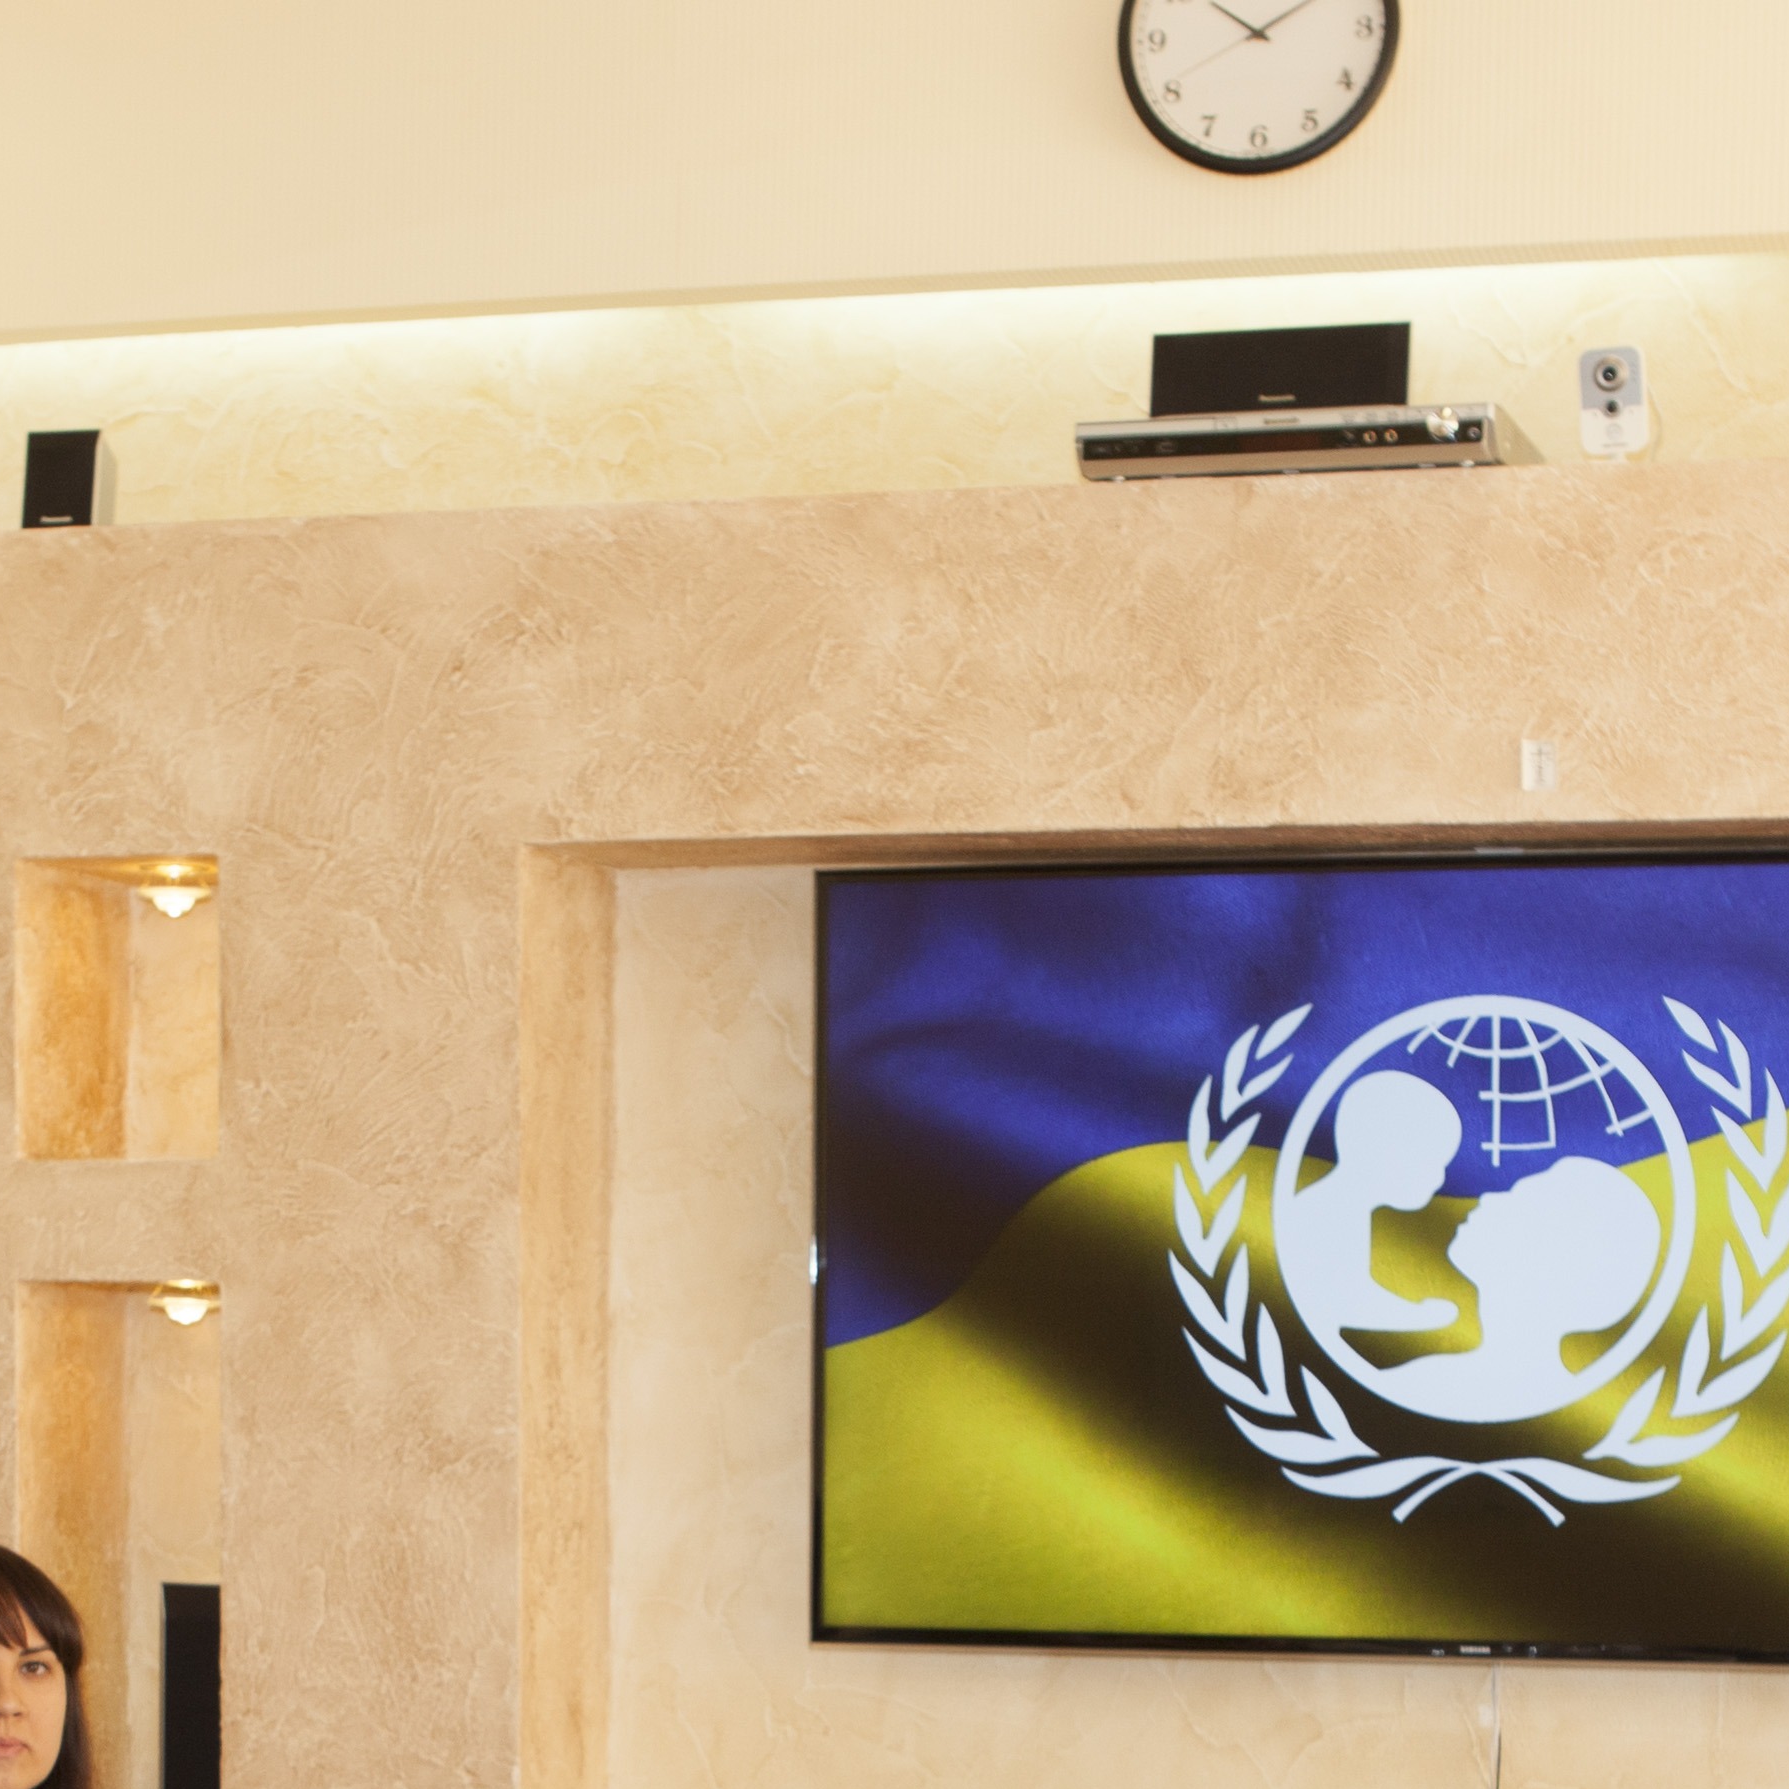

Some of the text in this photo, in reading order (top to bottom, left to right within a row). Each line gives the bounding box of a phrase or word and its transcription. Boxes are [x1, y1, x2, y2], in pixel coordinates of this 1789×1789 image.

[1356, 15, 1374, 39] 3
[1149, 29, 1166, 53] 9
[1163, 80, 1181, 102] 8
[1337, 68, 1354, 91] 4
[1201, 115, 1217, 137] 7
[1301, 109, 1318, 132] 5
[1250, 125, 1267, 149] 6
